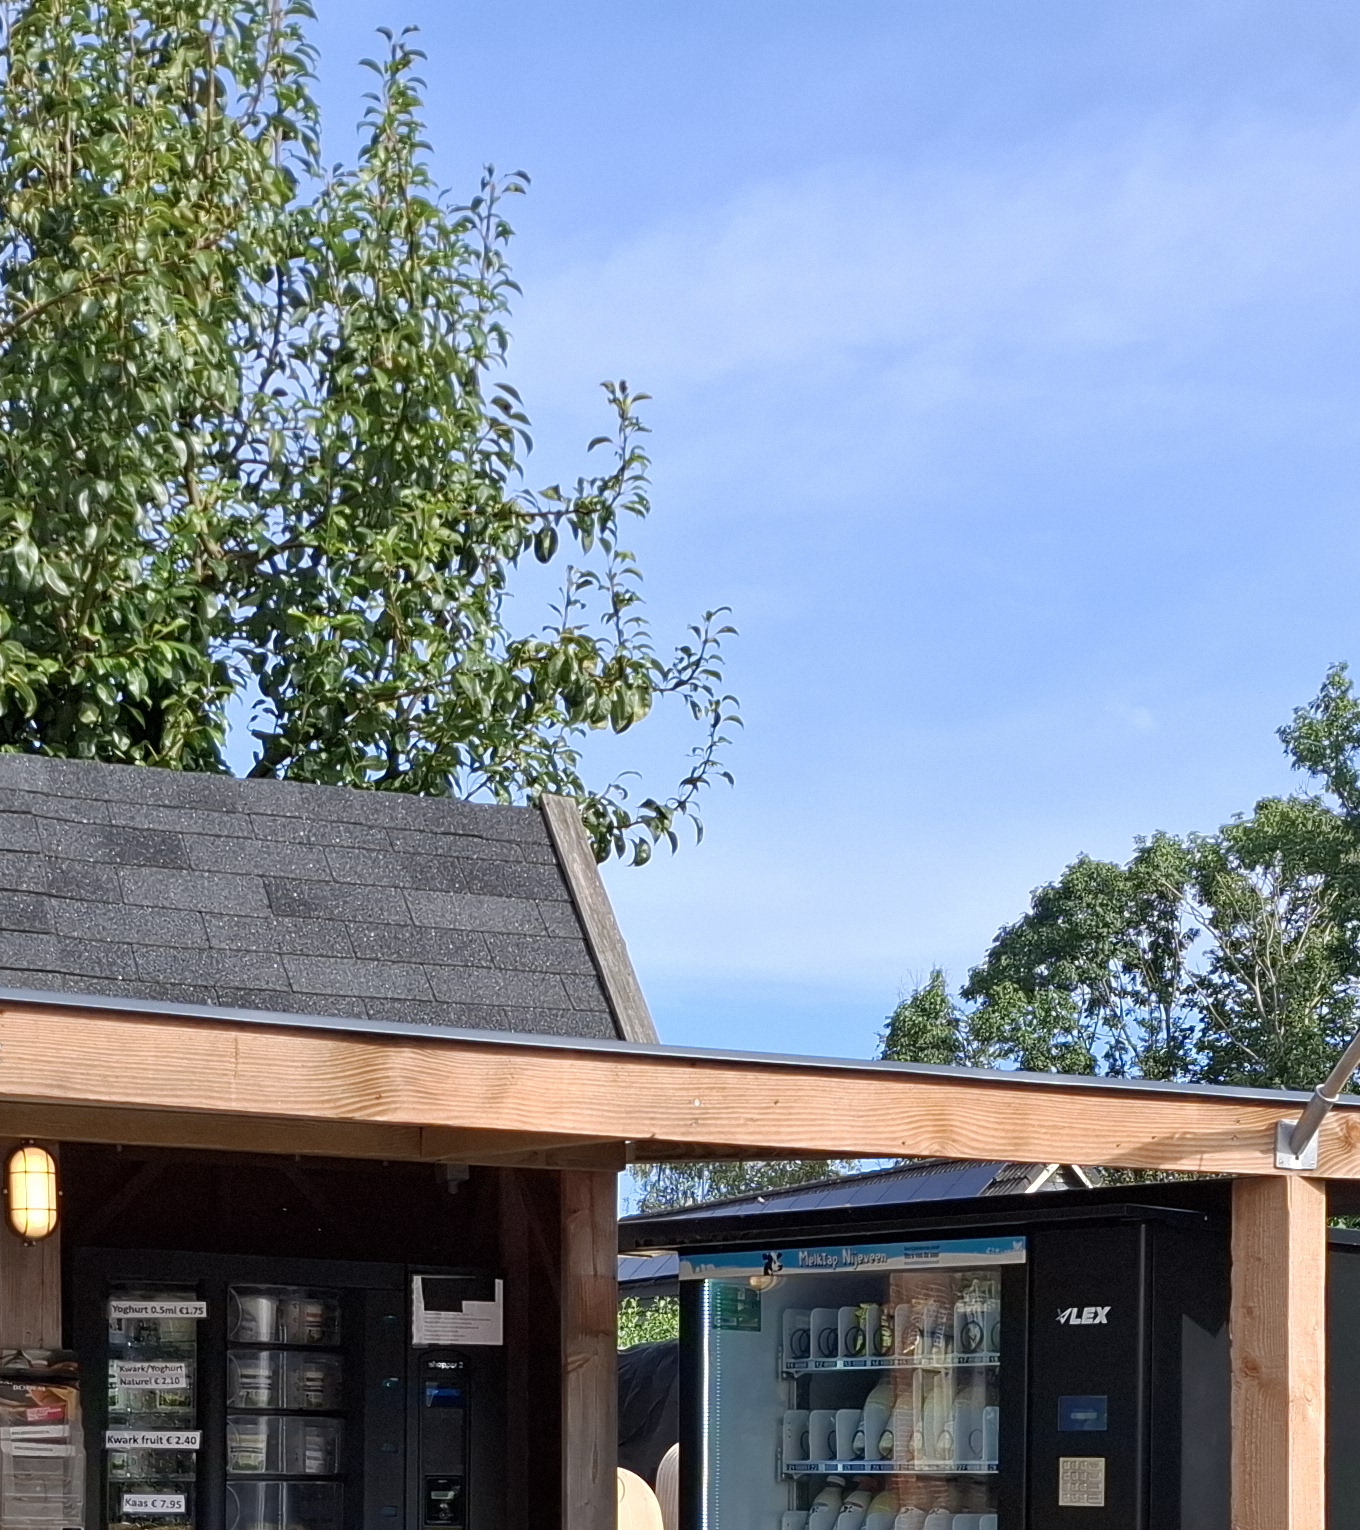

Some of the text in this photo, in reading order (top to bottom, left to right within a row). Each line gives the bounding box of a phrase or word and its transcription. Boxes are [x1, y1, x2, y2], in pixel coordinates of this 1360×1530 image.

[112, 1305, 204, 1316] Yoghurt 0.5ml €1.75
[120, 1364, 183, 1374] Kwark/Yoghurt
[120, 1377, 152, 1386] Naturel
[161, 1377, 180, 1385] 2.10
[107, 1434, 139, 1445] Kwark
[141, 1434, 164, 1445] fruit
[175, 1436, 197, 1445] 2.40
[124, 1498, 148, 1508] Kaas
[159, 1499, 182, 1509] 7.95
